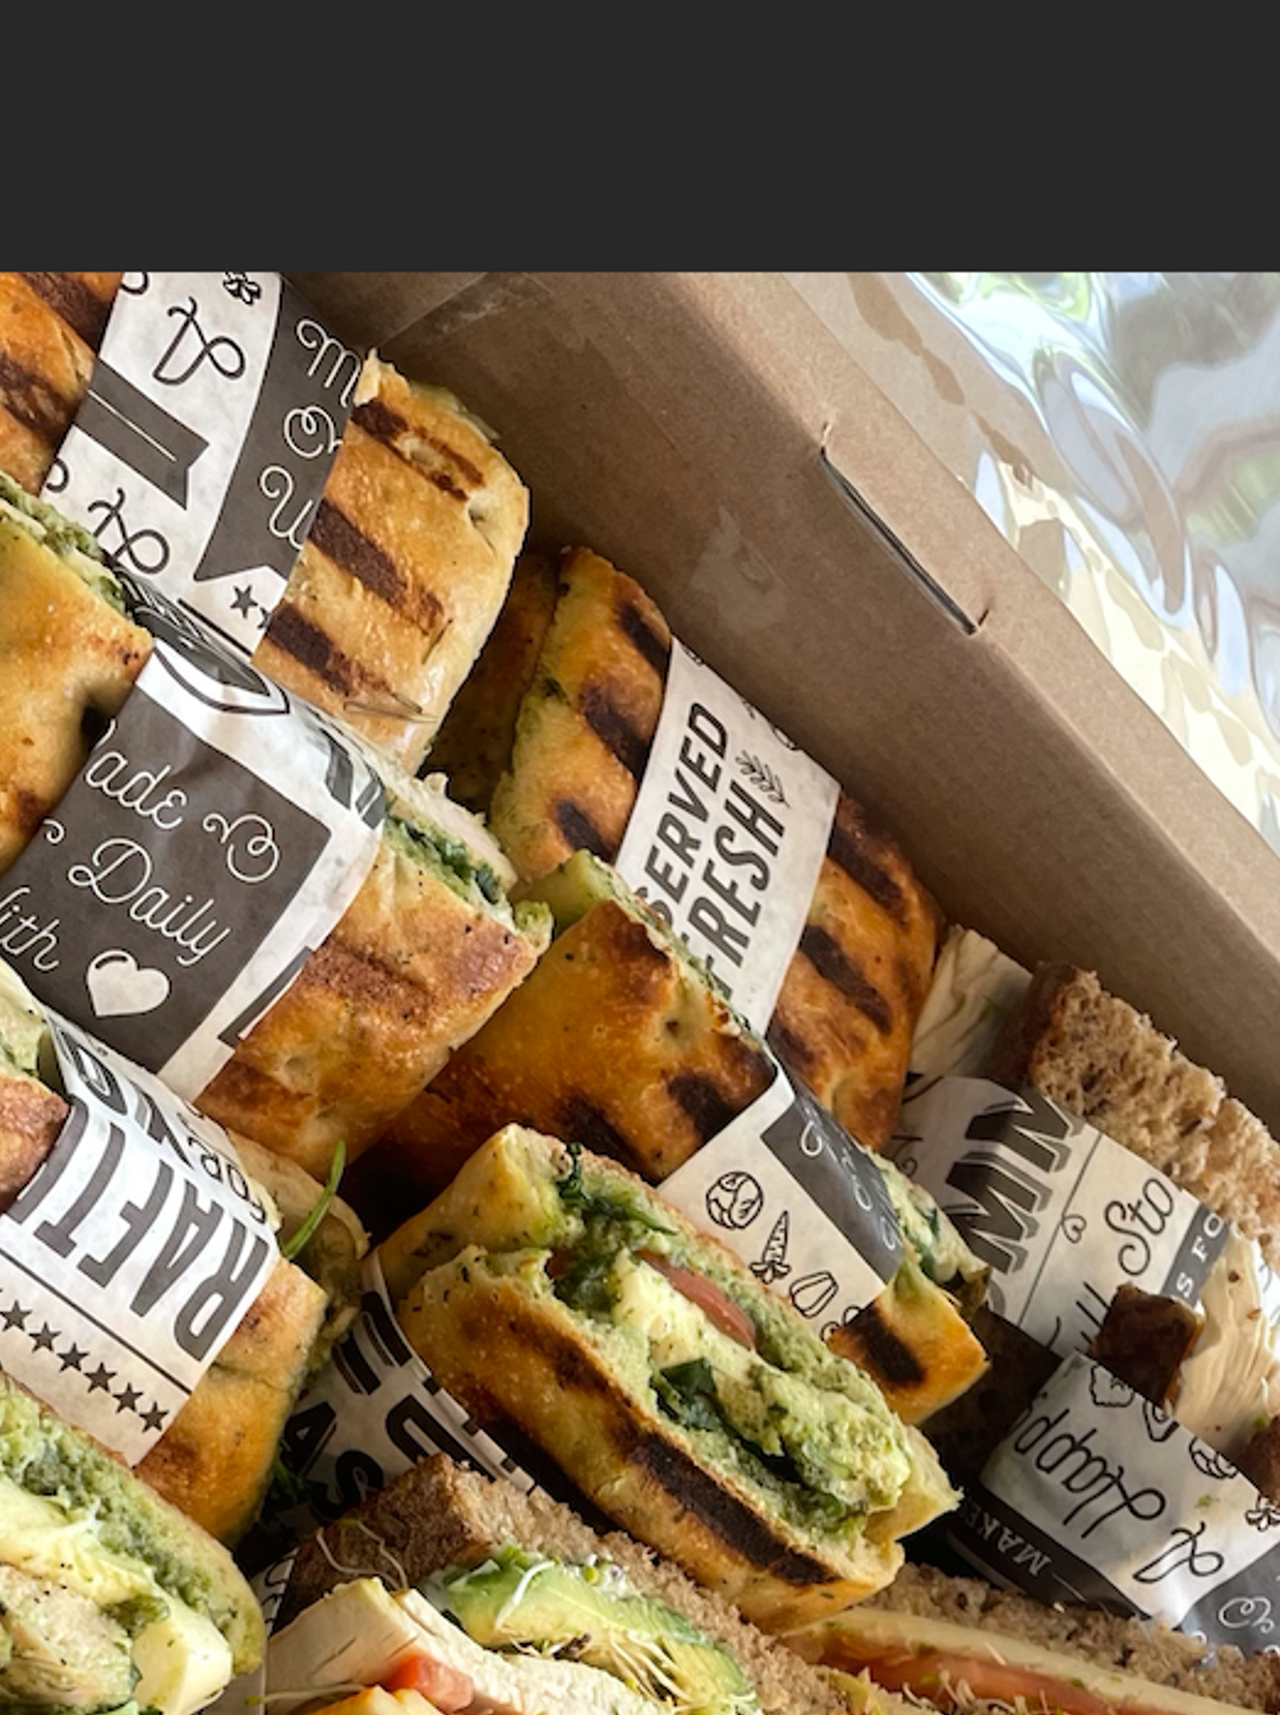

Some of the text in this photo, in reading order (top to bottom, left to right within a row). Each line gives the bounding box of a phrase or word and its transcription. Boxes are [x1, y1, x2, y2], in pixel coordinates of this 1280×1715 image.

[83, 722, 190, 831] ade
[66, 836, 230, 967] Daily
[4, 1098, 272, 1362] RAFT
[1103, 1177, 1177, 1276] Sto
[958, 1502, 1053, 1577] MAKE
